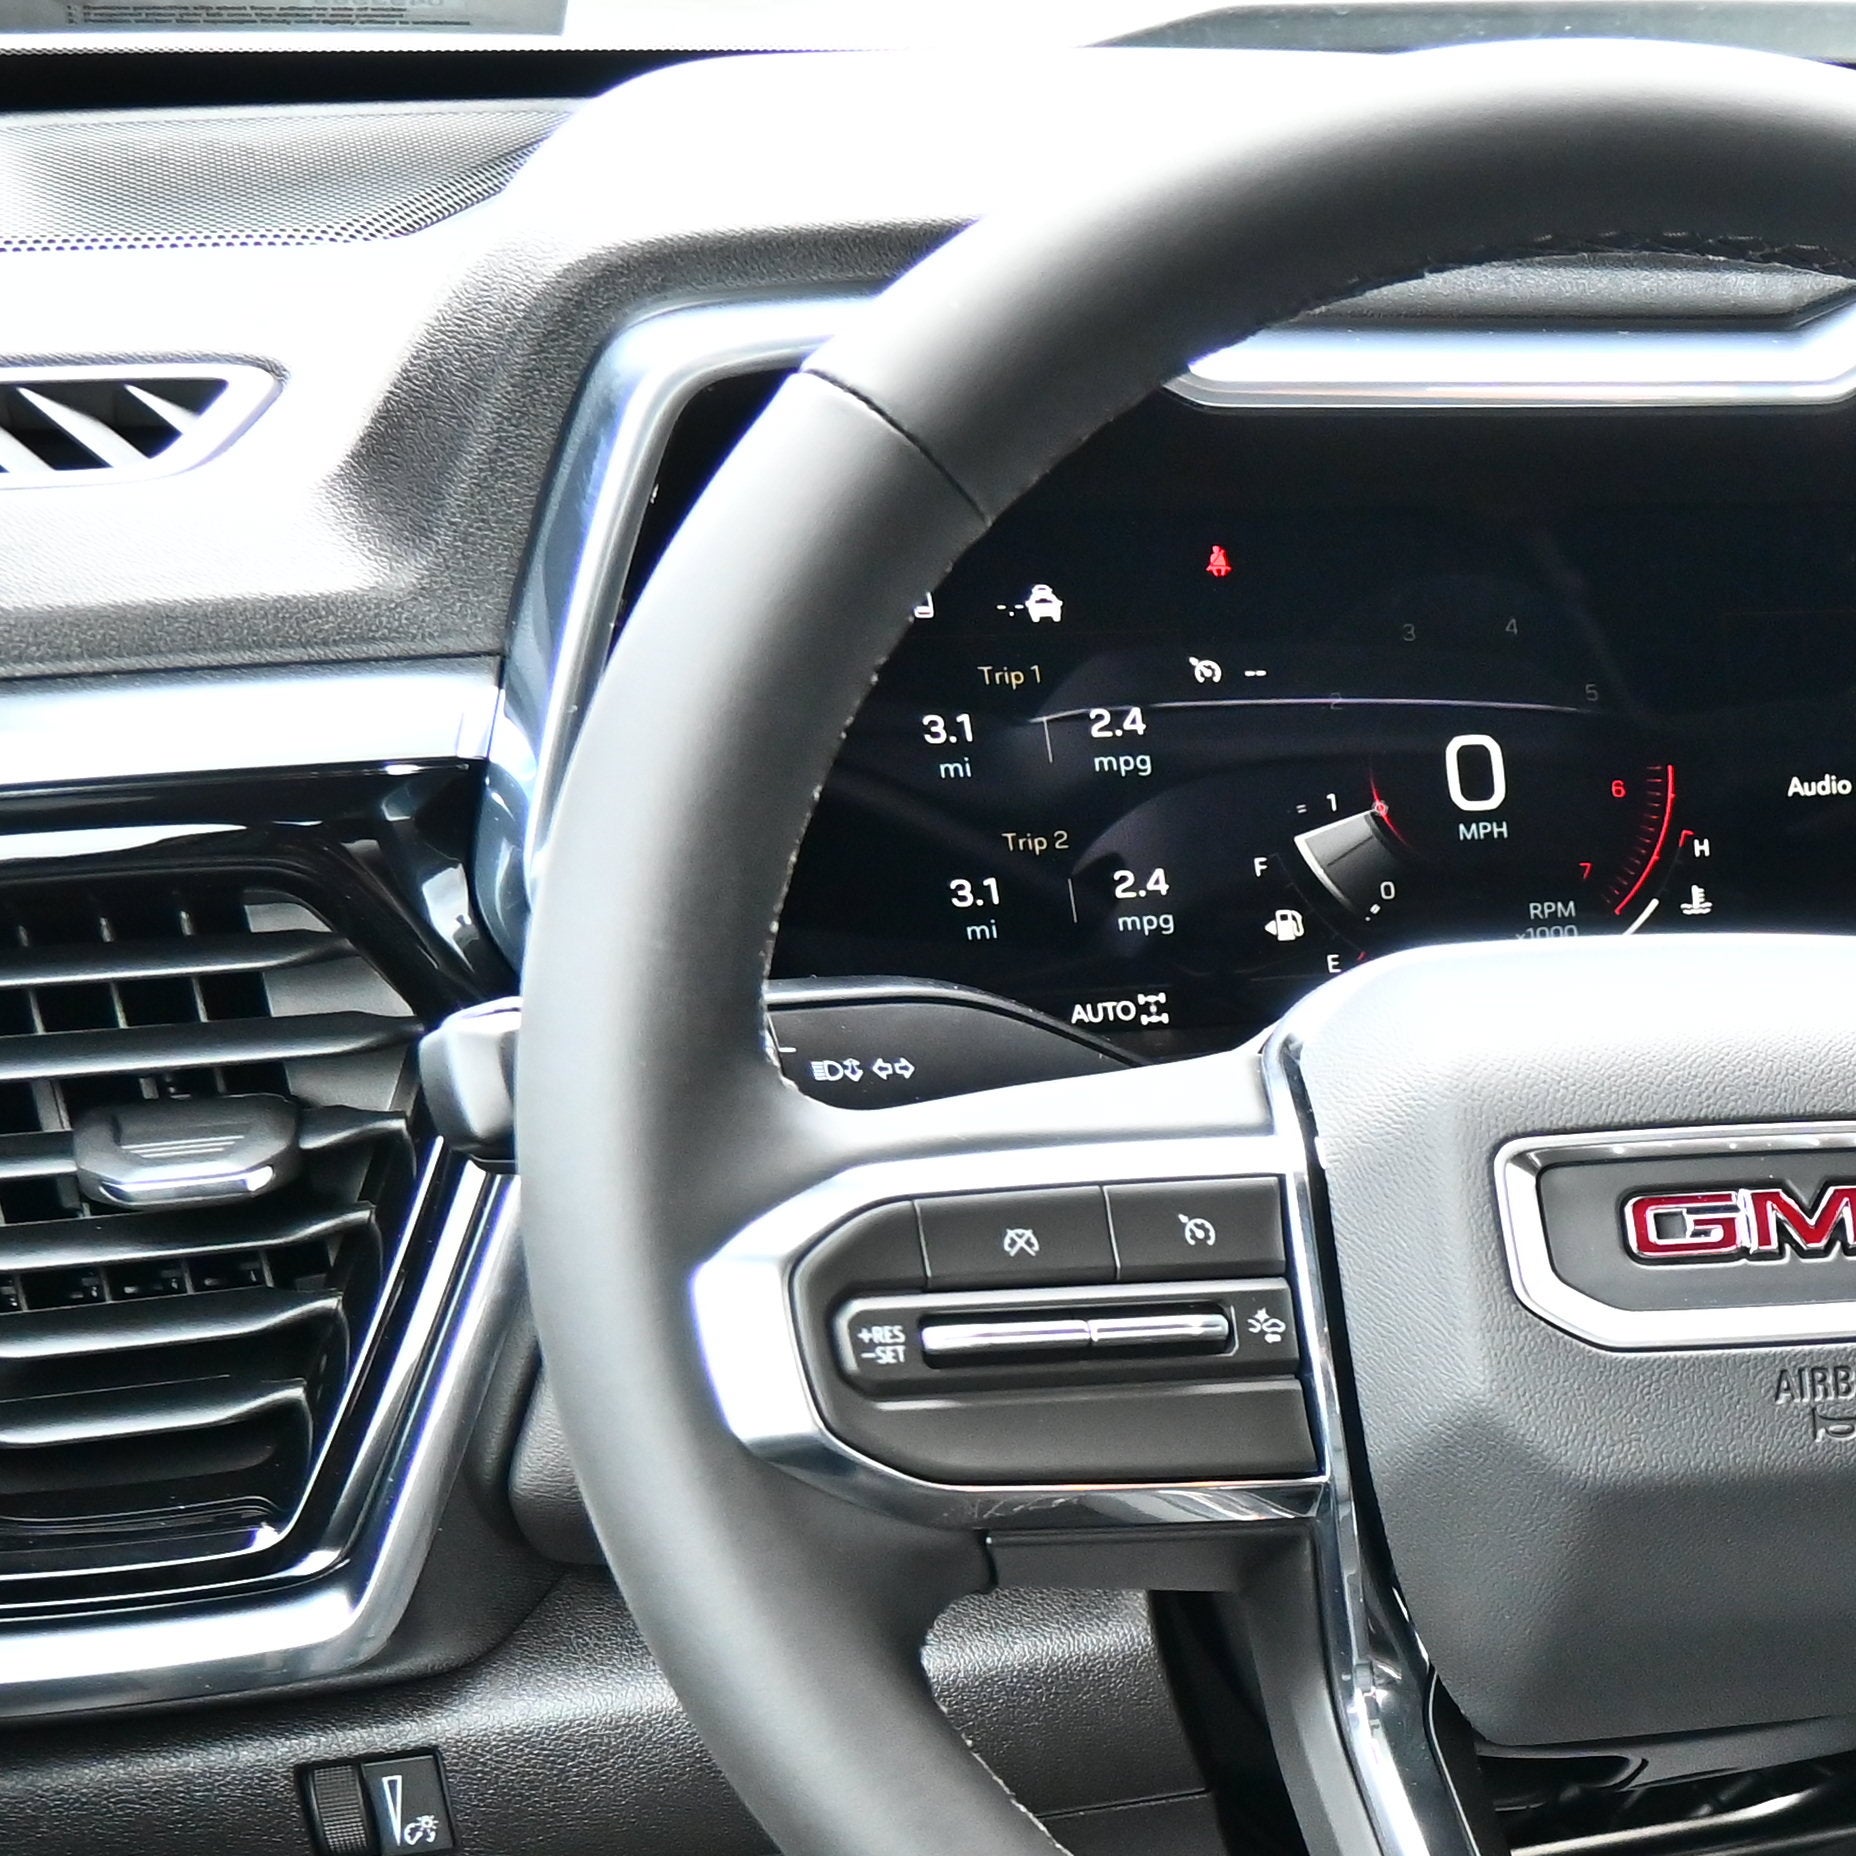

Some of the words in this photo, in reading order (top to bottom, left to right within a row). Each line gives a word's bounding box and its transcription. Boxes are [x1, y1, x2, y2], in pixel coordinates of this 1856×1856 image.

[978, 664, 1024, 688] Trip
[1033, 664, 1042, 684] 1
[922, 714, 974, 744] 3.1
[1089, 707, 1146, 738] 2.4
[939, 757, 972, 779] mi
[1094, 752, 1152, 779] mpg
[1445, 734, 1505, 811] 0
[1611, 780, 1625, 798] 6
[1787, 773, 1852, 798] Audio
[1326, 793, 1337, 811] 1
[1001, 831, 1048, 855] Trip
[1054, 830, 1069, 850] 2
[1458, 821, 1508, 840] MPH
[1693, 840, 1710, 856] H
[1254, 857, 1267, 877] F
[949, 878, 1001, 908] 3.1
[1114, 869, 1169, 898] 2.4
[1380, 881, 1396, 900] 0
[1529, 901, 1576, 920] RPM
[966, 920, 998, 941] mi
[1117, 911, 1175, 937] mpg
[1327, 954, 1341, 973] E
[1071, 1000, 1136, 1024] AUTO
